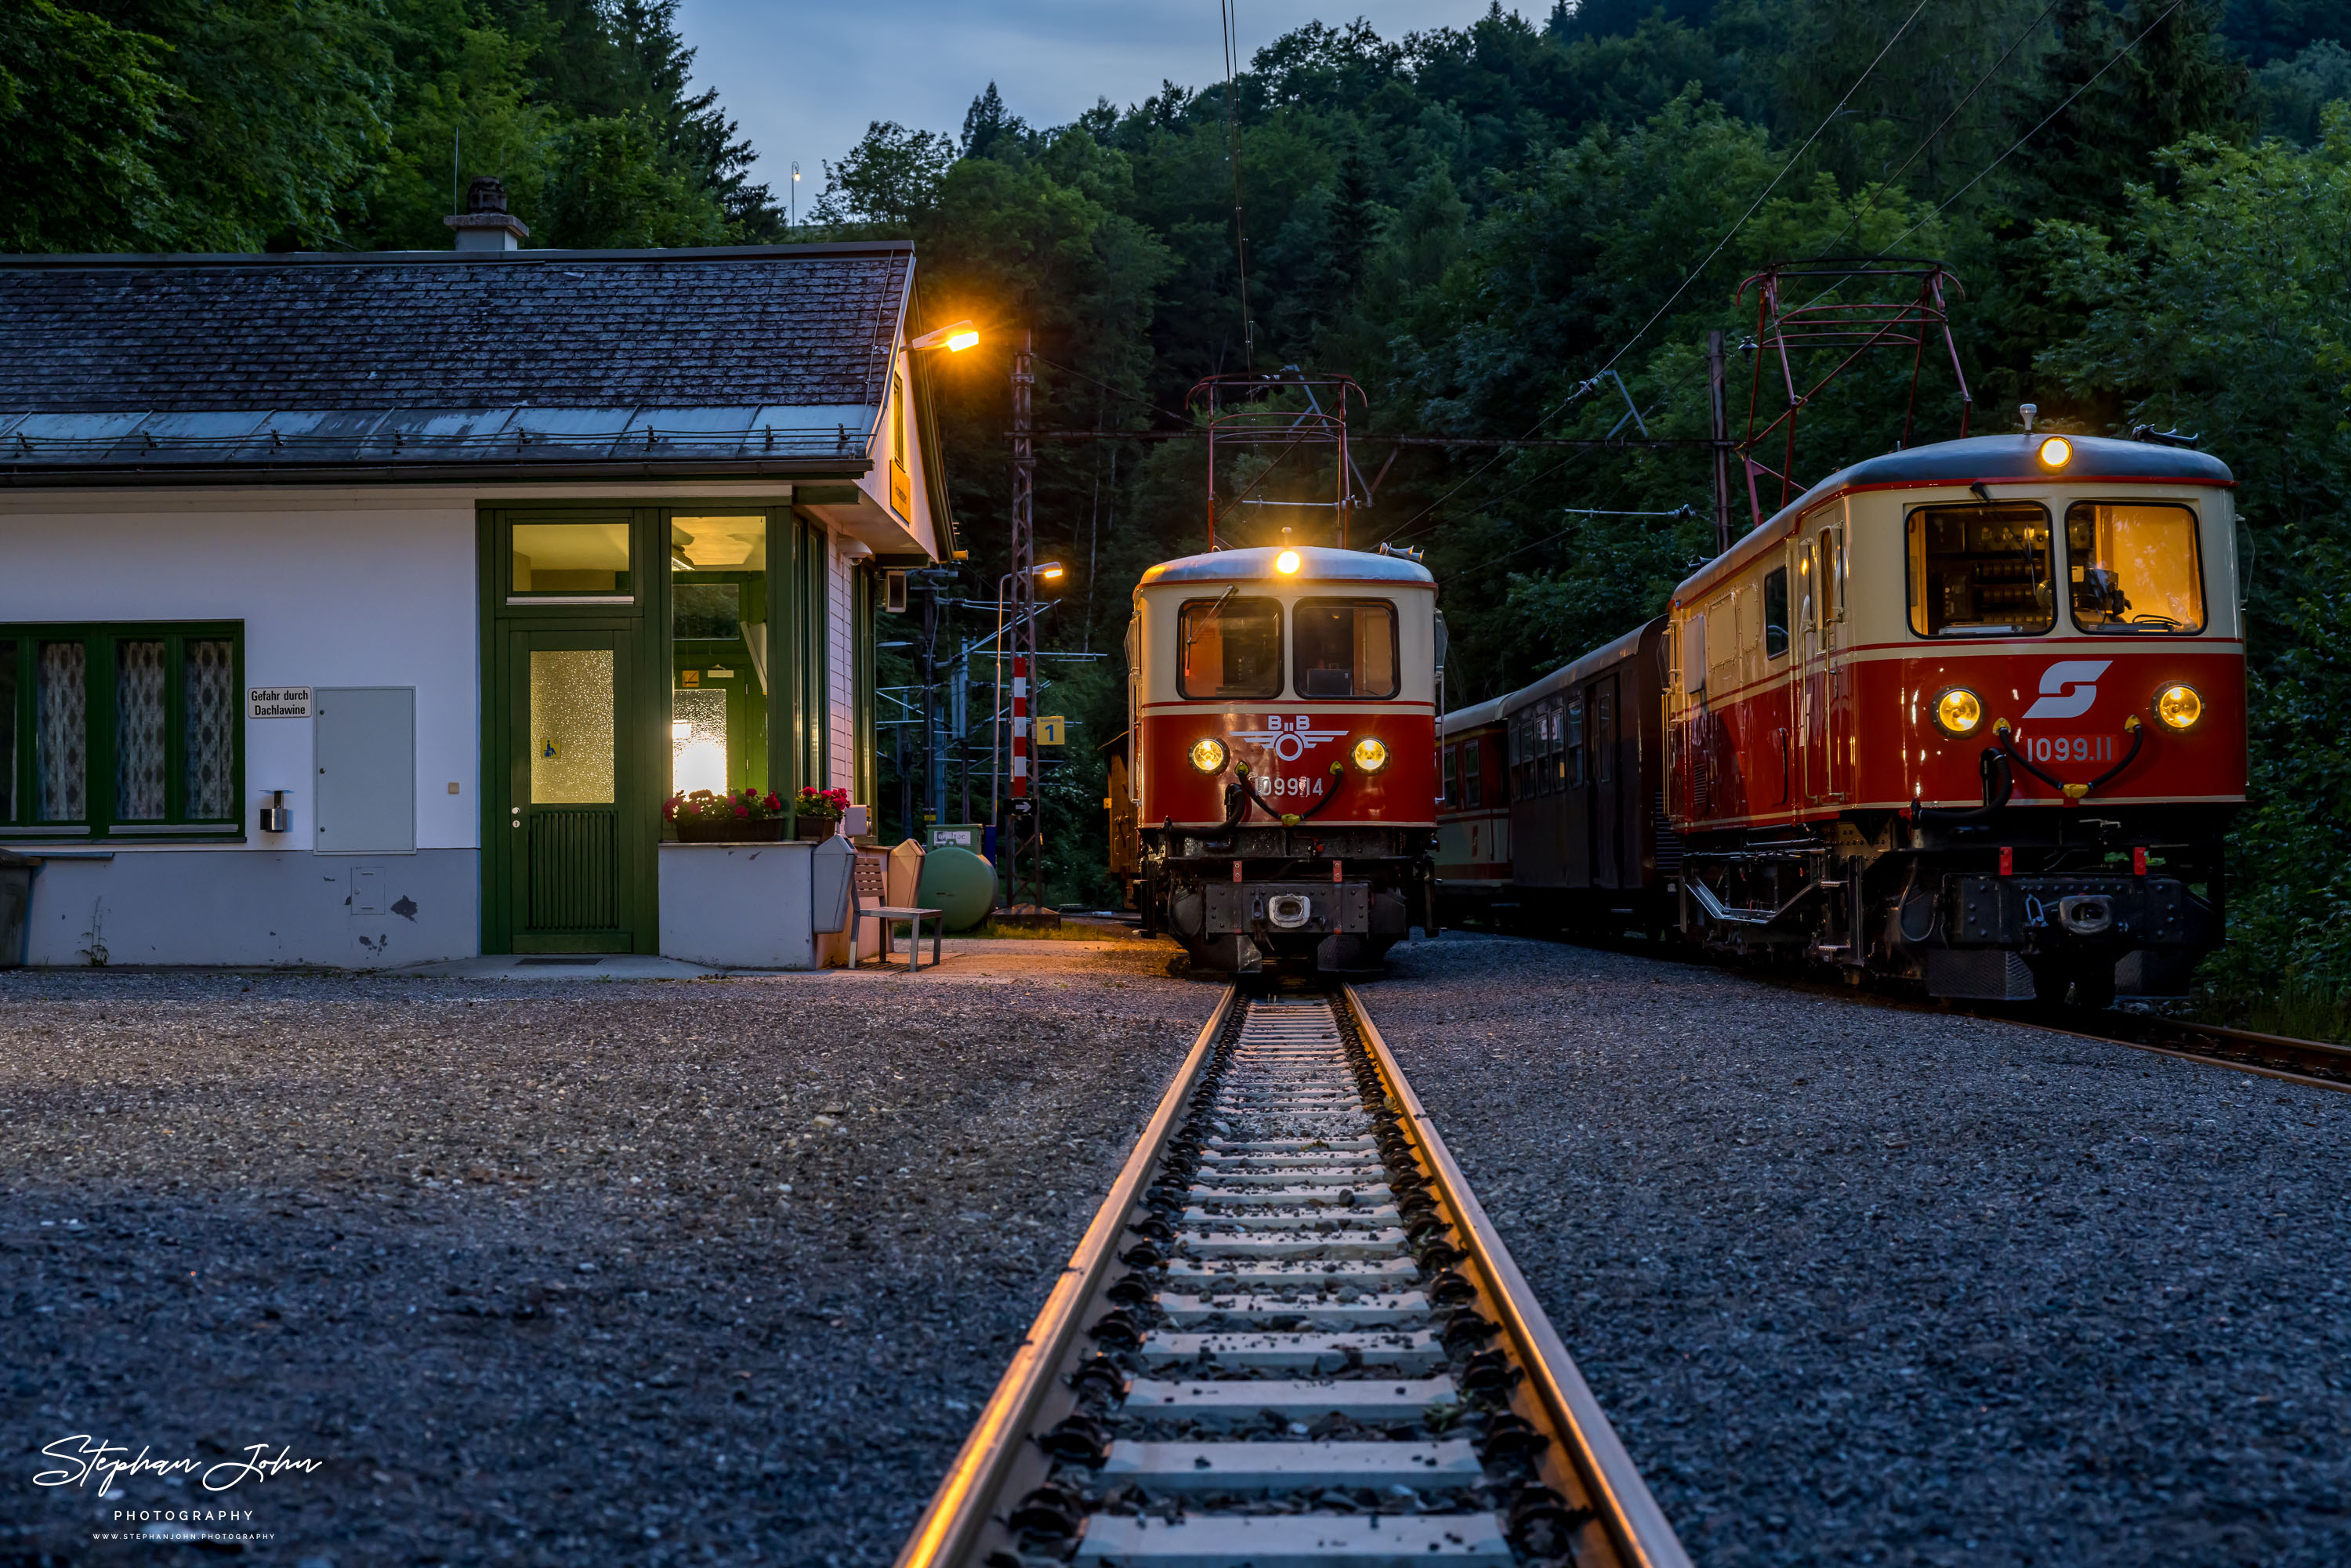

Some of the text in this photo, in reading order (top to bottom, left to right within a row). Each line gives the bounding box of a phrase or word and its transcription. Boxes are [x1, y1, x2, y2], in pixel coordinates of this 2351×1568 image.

[251, 690, 309, 701] Gefahr durch
[255, 704, 306, 715] Dachlawine
[1045, 724, 1054, 742] 1
[2027, 737, 2112, 762] 1099.11
[1255, 777, 1324, 796] 1099.14
